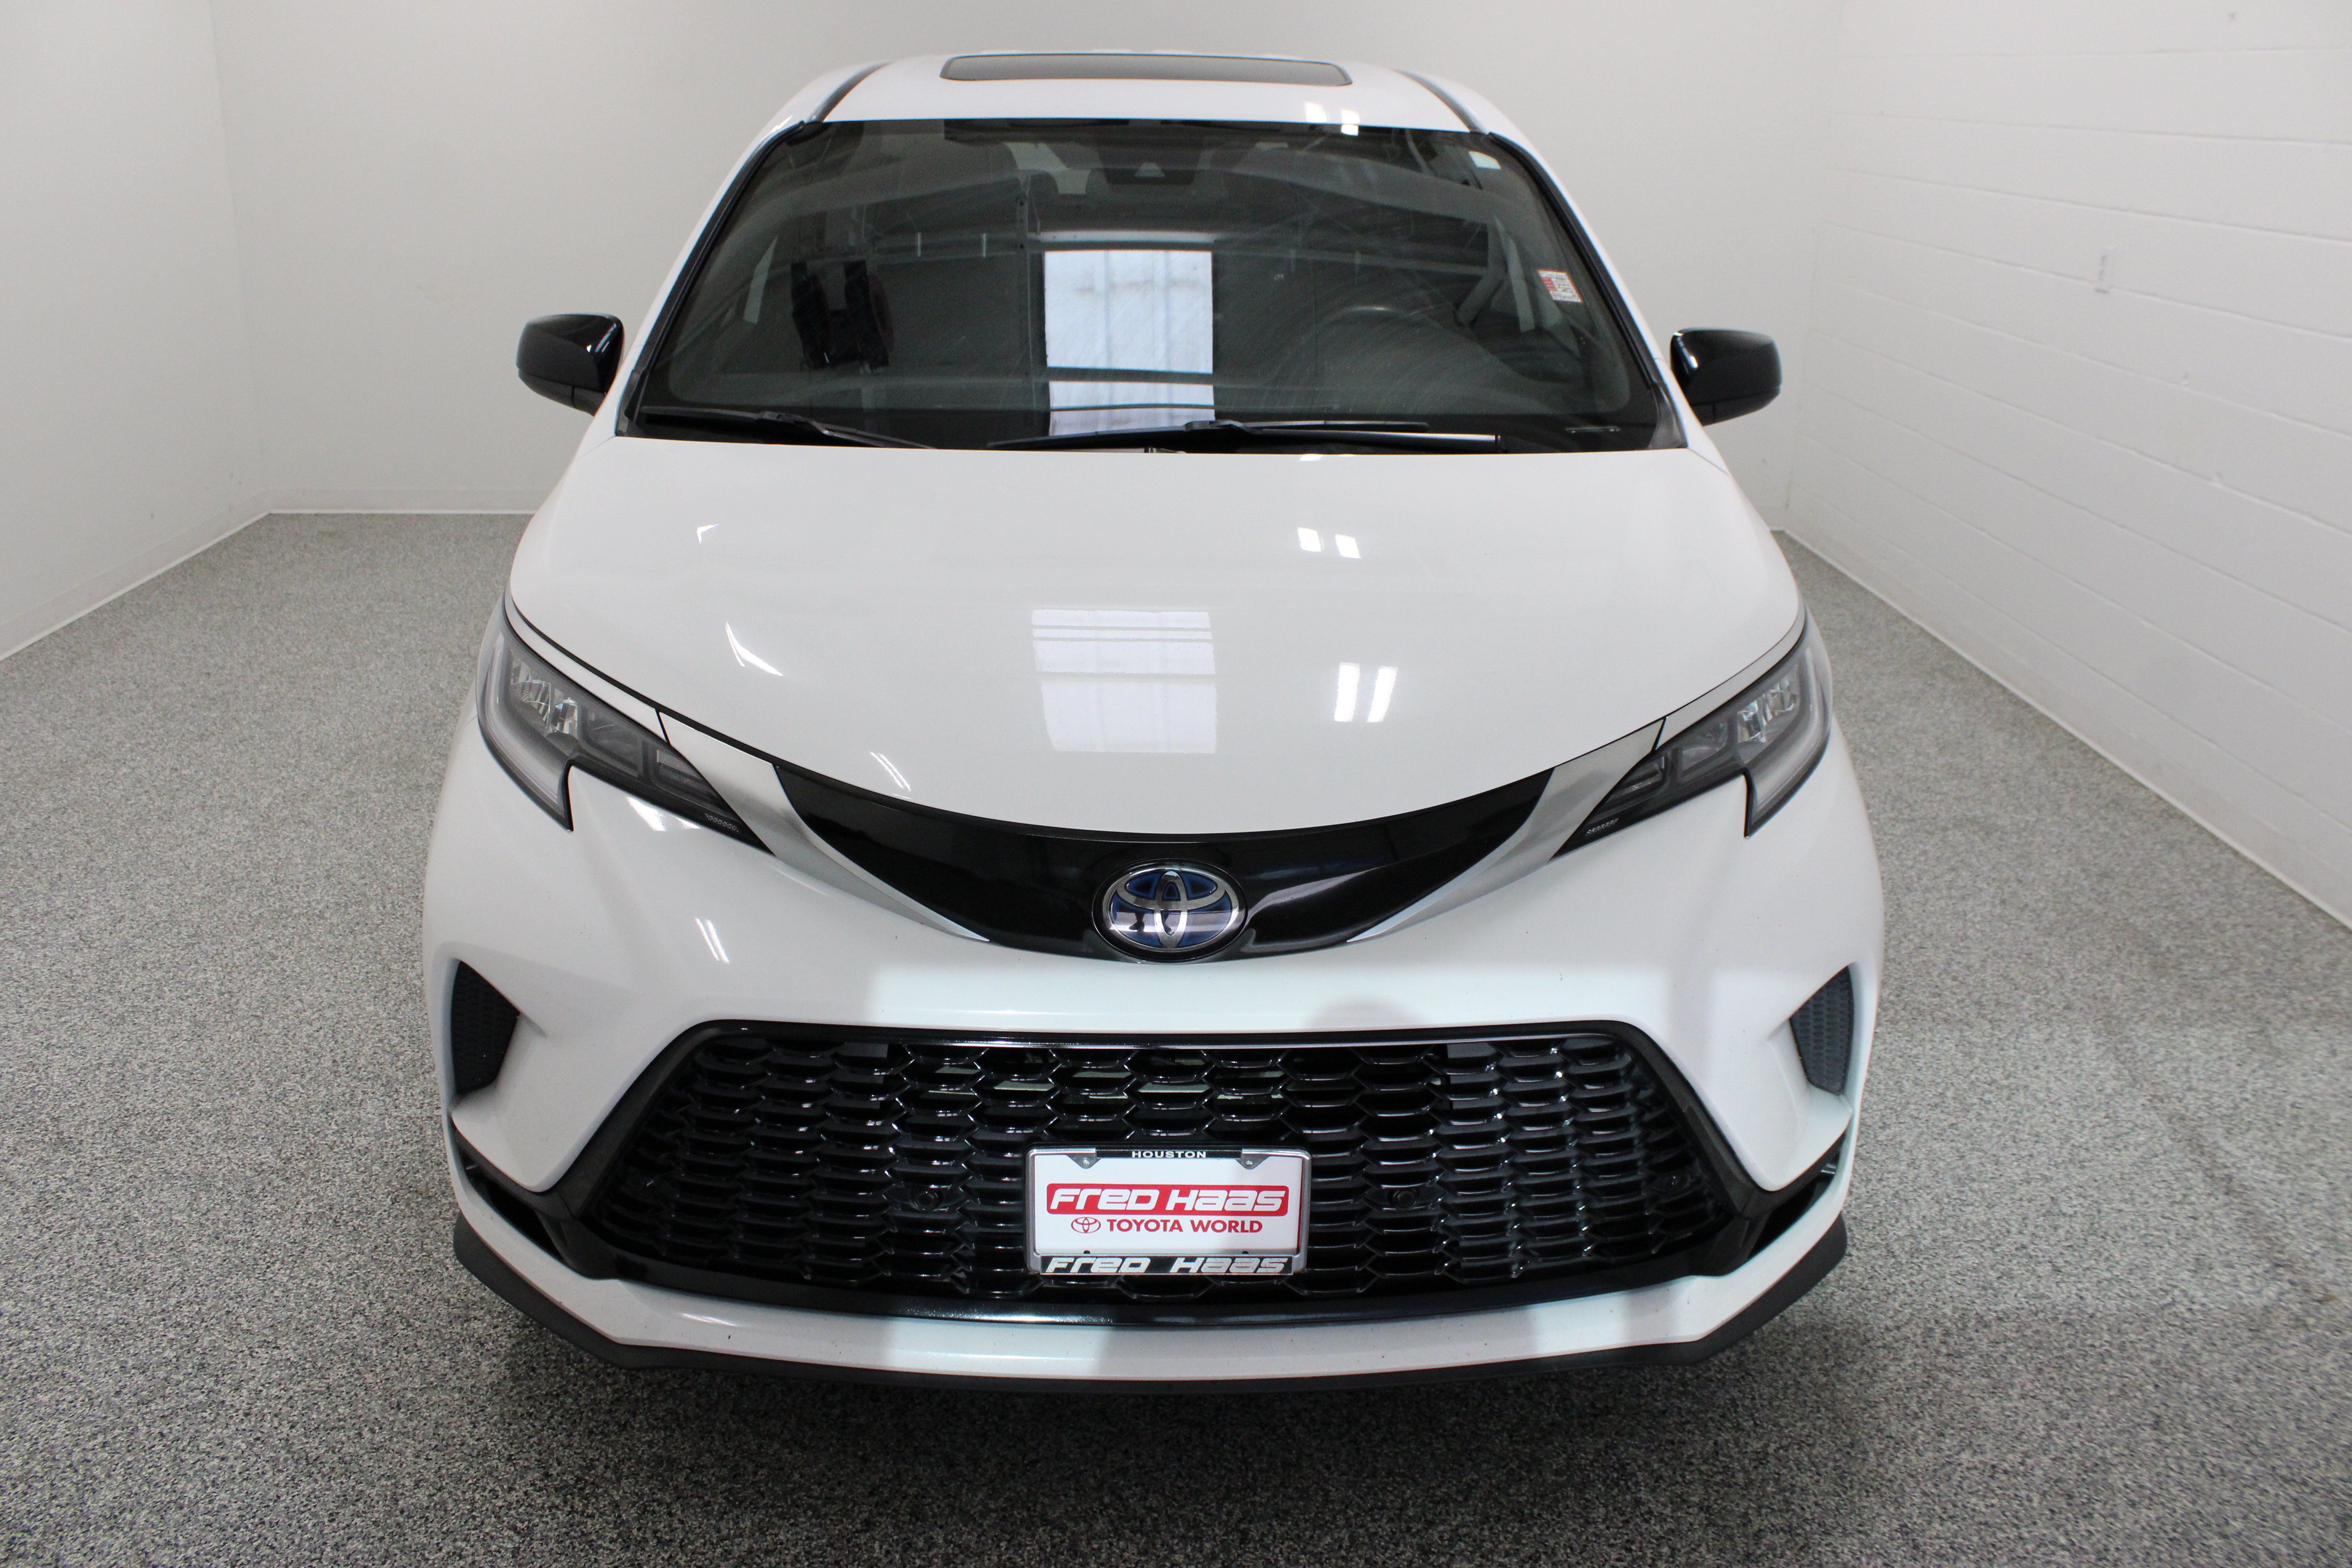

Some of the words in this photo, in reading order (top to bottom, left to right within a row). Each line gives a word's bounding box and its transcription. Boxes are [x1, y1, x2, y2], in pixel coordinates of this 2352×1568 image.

[1132, 1151, 1207, 1159] HOUSTON
[1107, 1218, 1183, 1232] TOYOTA
[1190, 1219, 1263, 1233] WORLD
